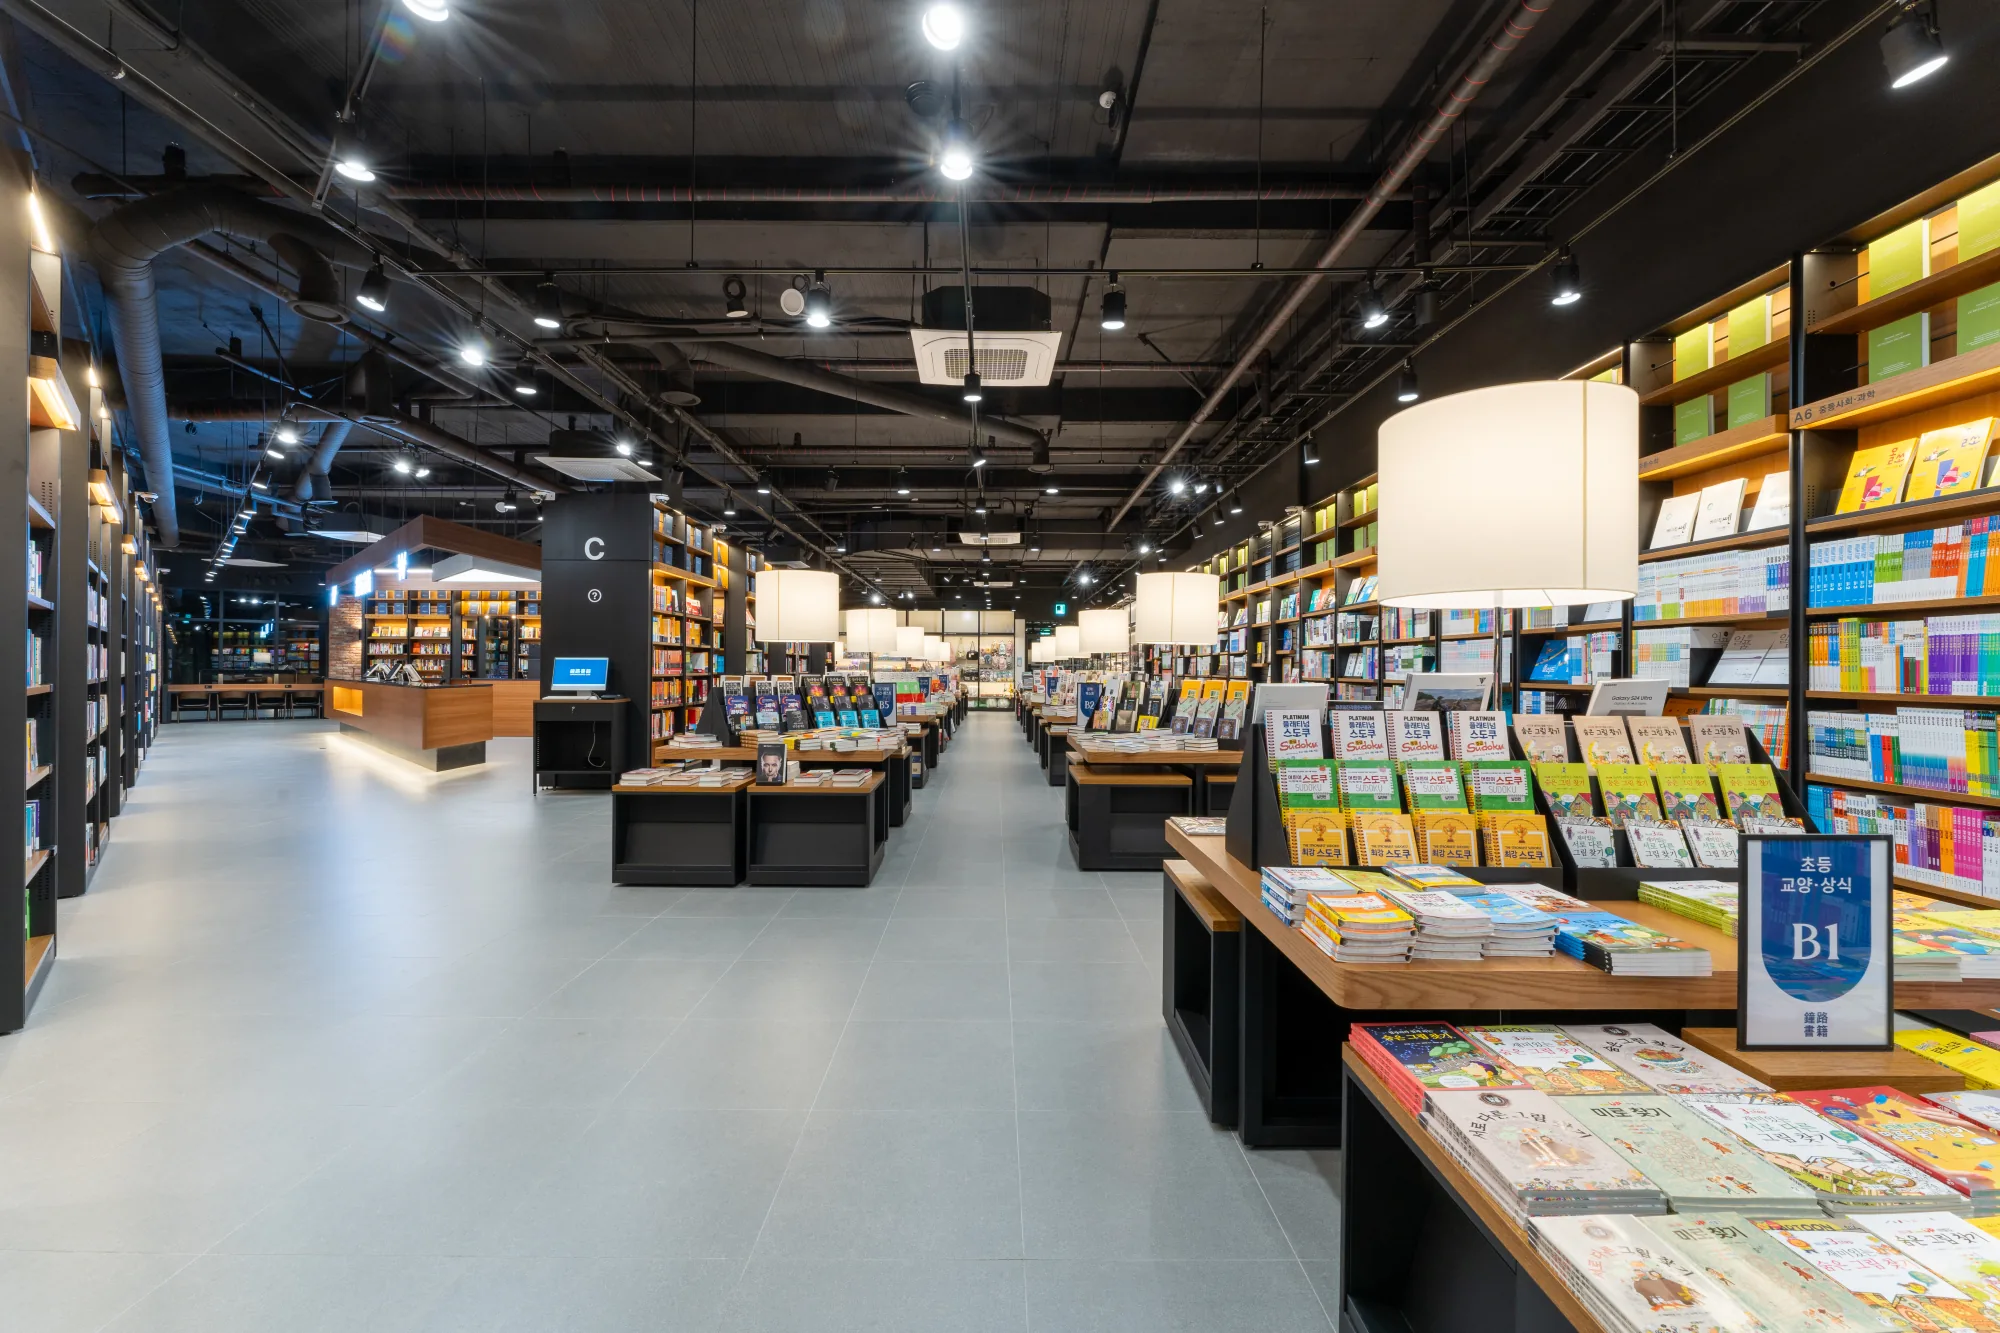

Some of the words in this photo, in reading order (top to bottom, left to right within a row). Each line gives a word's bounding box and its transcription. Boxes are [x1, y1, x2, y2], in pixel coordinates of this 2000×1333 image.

[1794, 408, 1813, 423] A6
[584, 537, 605, 561] C
[880, 700, 890, 710] B5
[1084, 700, 1094, 710] B2
[1282, 720, 1310, 728] 플래티넘
[1283, 728, 1310, 738] 스도쿠
[1350, 729, 1376, 738] 스도쿠
[1405, 730, 1431, 739] 스도쿠
[1470, 730, 1497, 739] 스도쿠
[1280, 739, 1318, 752] Sudoku
[1346, 740, 1384, 752] Sudoku
[1401, 740, 1439, 753] Sudoku
[1466, 741, 1505, 753] Sudoku
[1302, 774, 1328, 783] 스도쿠
[1363, 776, 1388, 784] 스도쿠
[1430, 776, 1454, 784] 스도쿠
[1496, 776, 1523, 785] 스도쿠
[1356, 784, 1383, 792] SUDOKU
[1302, 848, 1315, 857] 최강
[1317, 848, 1342, 858] 스도쿠
[1371, 849, 1384, 857] 최강
[1386, 849, 1411, 859] 스도쿠
[1432, 849, 1445, 857] 최강
[1447, 849, 1472, 859] 스도쿠
[1505, 851, 1518, 859] 최강
[1519, 851, 1544, 860] 스도쿠
[1573, 849, 1587, 857] 그림
[1589, 849, 1604, 857] 찾기
[1645, 850, 1660, 858] 그림
[1662, 850, 1678, 858] 찾기
[1705, 850, 1720, 858] 그림
[1721, 850, 1736, 858] 찾기
[1800, 856, 1832, 873] 초등
[1780, 877, 1852, 894] 교양·상식
[1792, 922, 1840, 960] B1
[1430, 1032, 1453, 1040] 찾기
[1804, 1025, 1828, 1038] 書籍
[1652, 1040, 1686, 1052] 찾기
[1500, 1048, 1526, 1056] 숨은
[1477, 1110, 1508, 1122] 다른
[1512, 1112, 1546, 1123] 그림
[1590, 1107, 1632, 1118] 미로
[1628, 1107, 1672, 1118] 찾기
[1469, 1122, 1488, 1139] 서로
[1744, 1122, 1780, 1132] 서로
[1780, 1122, 1820, 1132] 다른
[1758, 1132, 1797, 1143] 그림
[1794, 1132, 1839, 1143] 찾기
[1672, 1228, 1714, 1241] 미로
[1706, 1226, 1748, 1239] 찾기
[1894, 1235, 1928, 1246] 숨은
[1924, 1234, 1960, 1244] 그림
[1950, 1231, 1991, 1243] 찾기
[1590, 1246, 1618, 1259] 다른
[1617, 1246, 1651, 1259] 그림
[1824, 1248, 1878, 1258] 재미있는
[1588, 1260, 1605, 1279] 서로
[1658, 1256, 1694, 1276] 찾기
[1817, 1260, 1852, 1272] 숨은
[1850, 1258, 1886, 1270] 그림
[1882, 1258, 1920, 1270] 찾기
